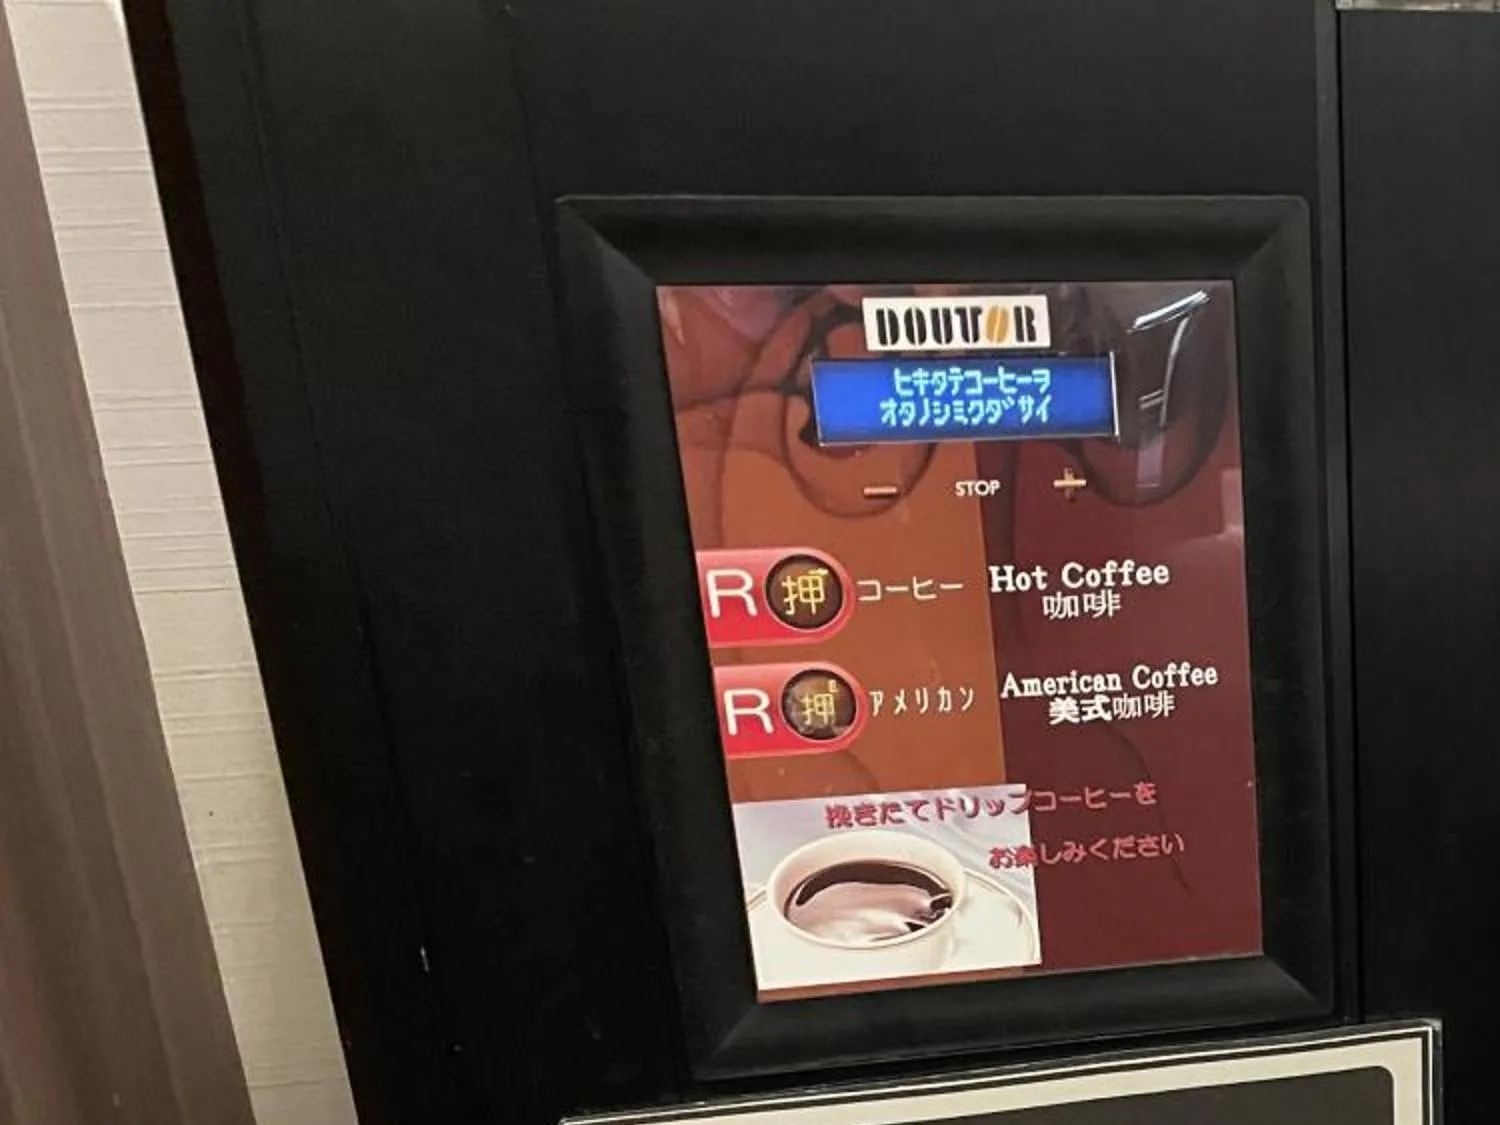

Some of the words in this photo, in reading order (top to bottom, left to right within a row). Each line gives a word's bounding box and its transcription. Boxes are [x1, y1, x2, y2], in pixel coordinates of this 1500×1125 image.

[875, 306, 1038, 346] DOUTOR
[893, 366, 1051, 396] ヒキタテコーヒーヲ
[955, 481, 1001, 498] STOP
[706, 569, 758, 618] R
[856, 576, 964, 602] コーヒー
[988, 565, 1050, 594] Hot
[1062, 561, 1170, 589] Coffee
[781, 573, 827, 616] 押
[1043, 589, 1122, 620] 咖啡
[1000, 668, 1123, 699] American
[1131, 662, 1219, 691] Coffee
[723, 688, 775, 736] R
[869, 686, 974, 718] アメリカン
[1048, 692, 1176, 726] 美式咖啡
